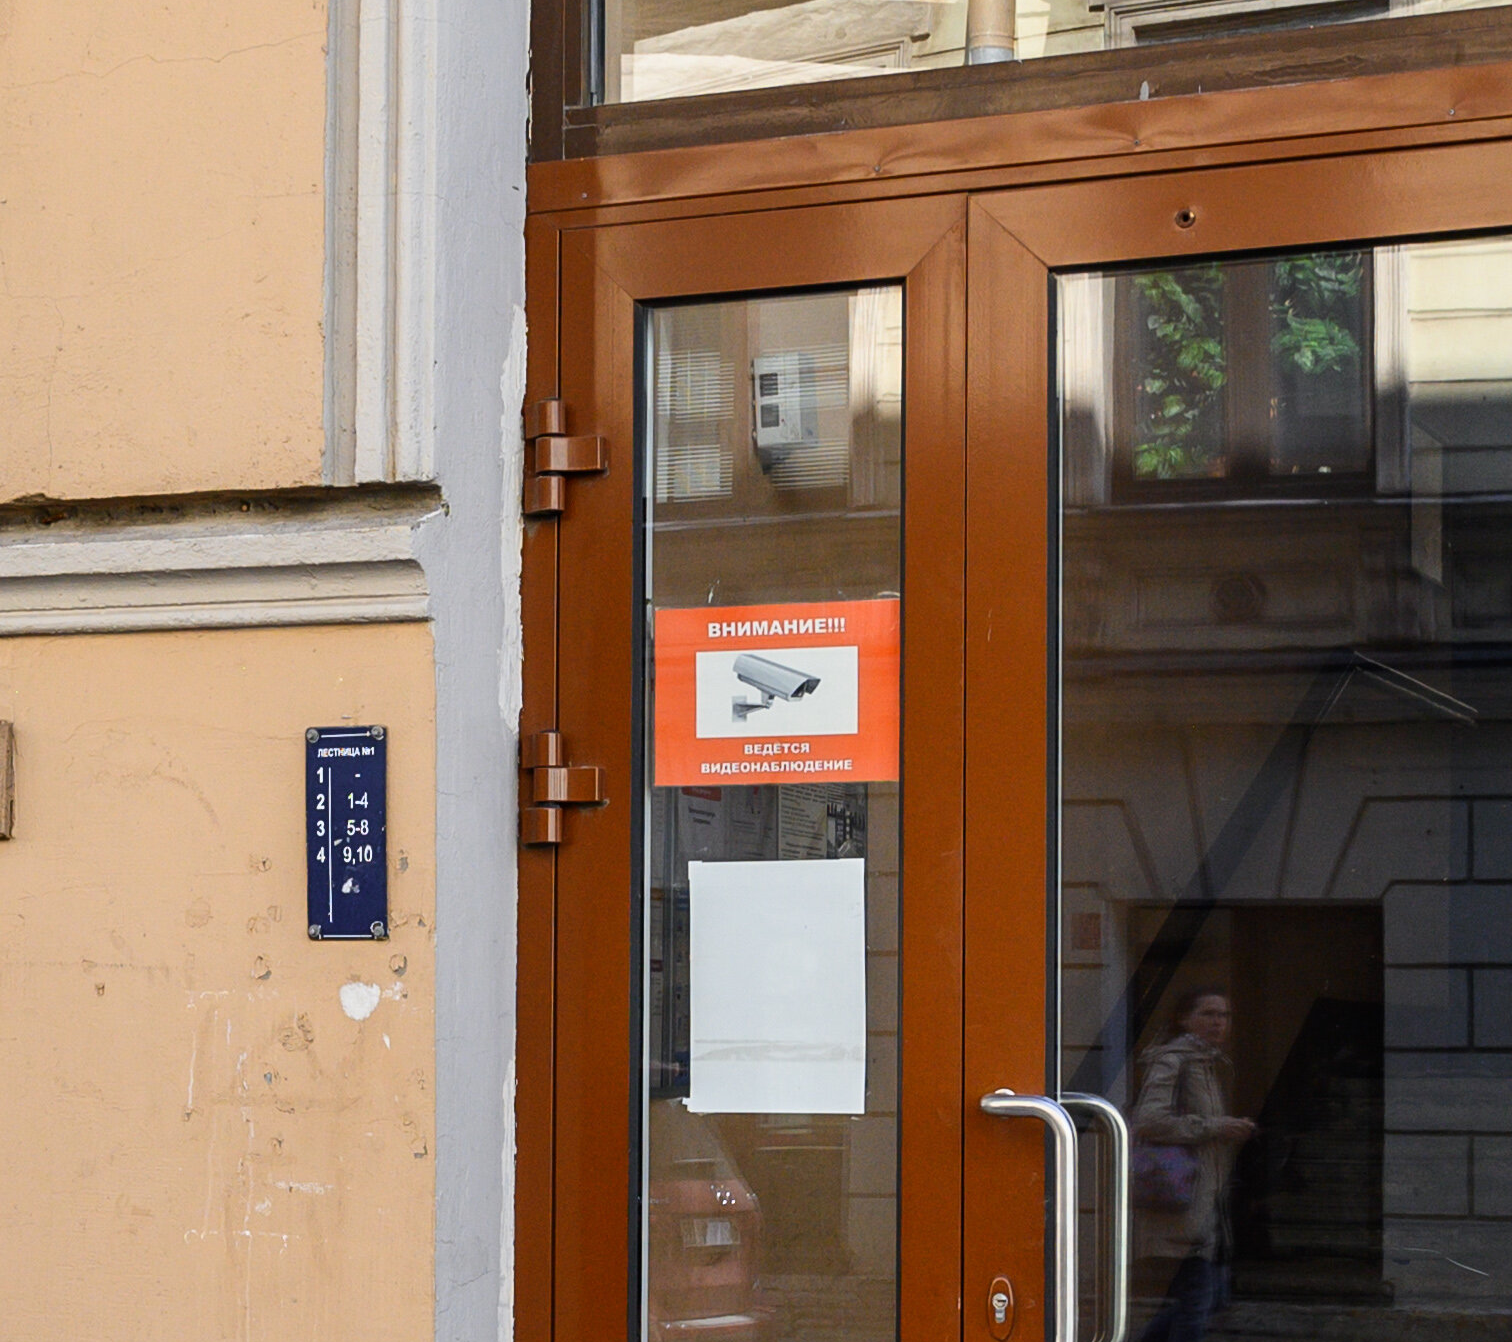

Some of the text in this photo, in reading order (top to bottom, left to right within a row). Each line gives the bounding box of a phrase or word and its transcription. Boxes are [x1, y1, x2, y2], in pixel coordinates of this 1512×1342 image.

[707, 617, 846, 638] ВНИМАНИЕ!!!
[317, 746, 375, 758] ЛЕСТНИЦА №1
[316, 767, 324, 784] 1
[701, 759, 853, 775] ВИДЕОНАБЛЮДЕНИЕ
[316, 792, 369, 811] 2 1-4
[316, 819, 369, 837] 3 5-8
[316, 845, 374, 865] 4 9,10
